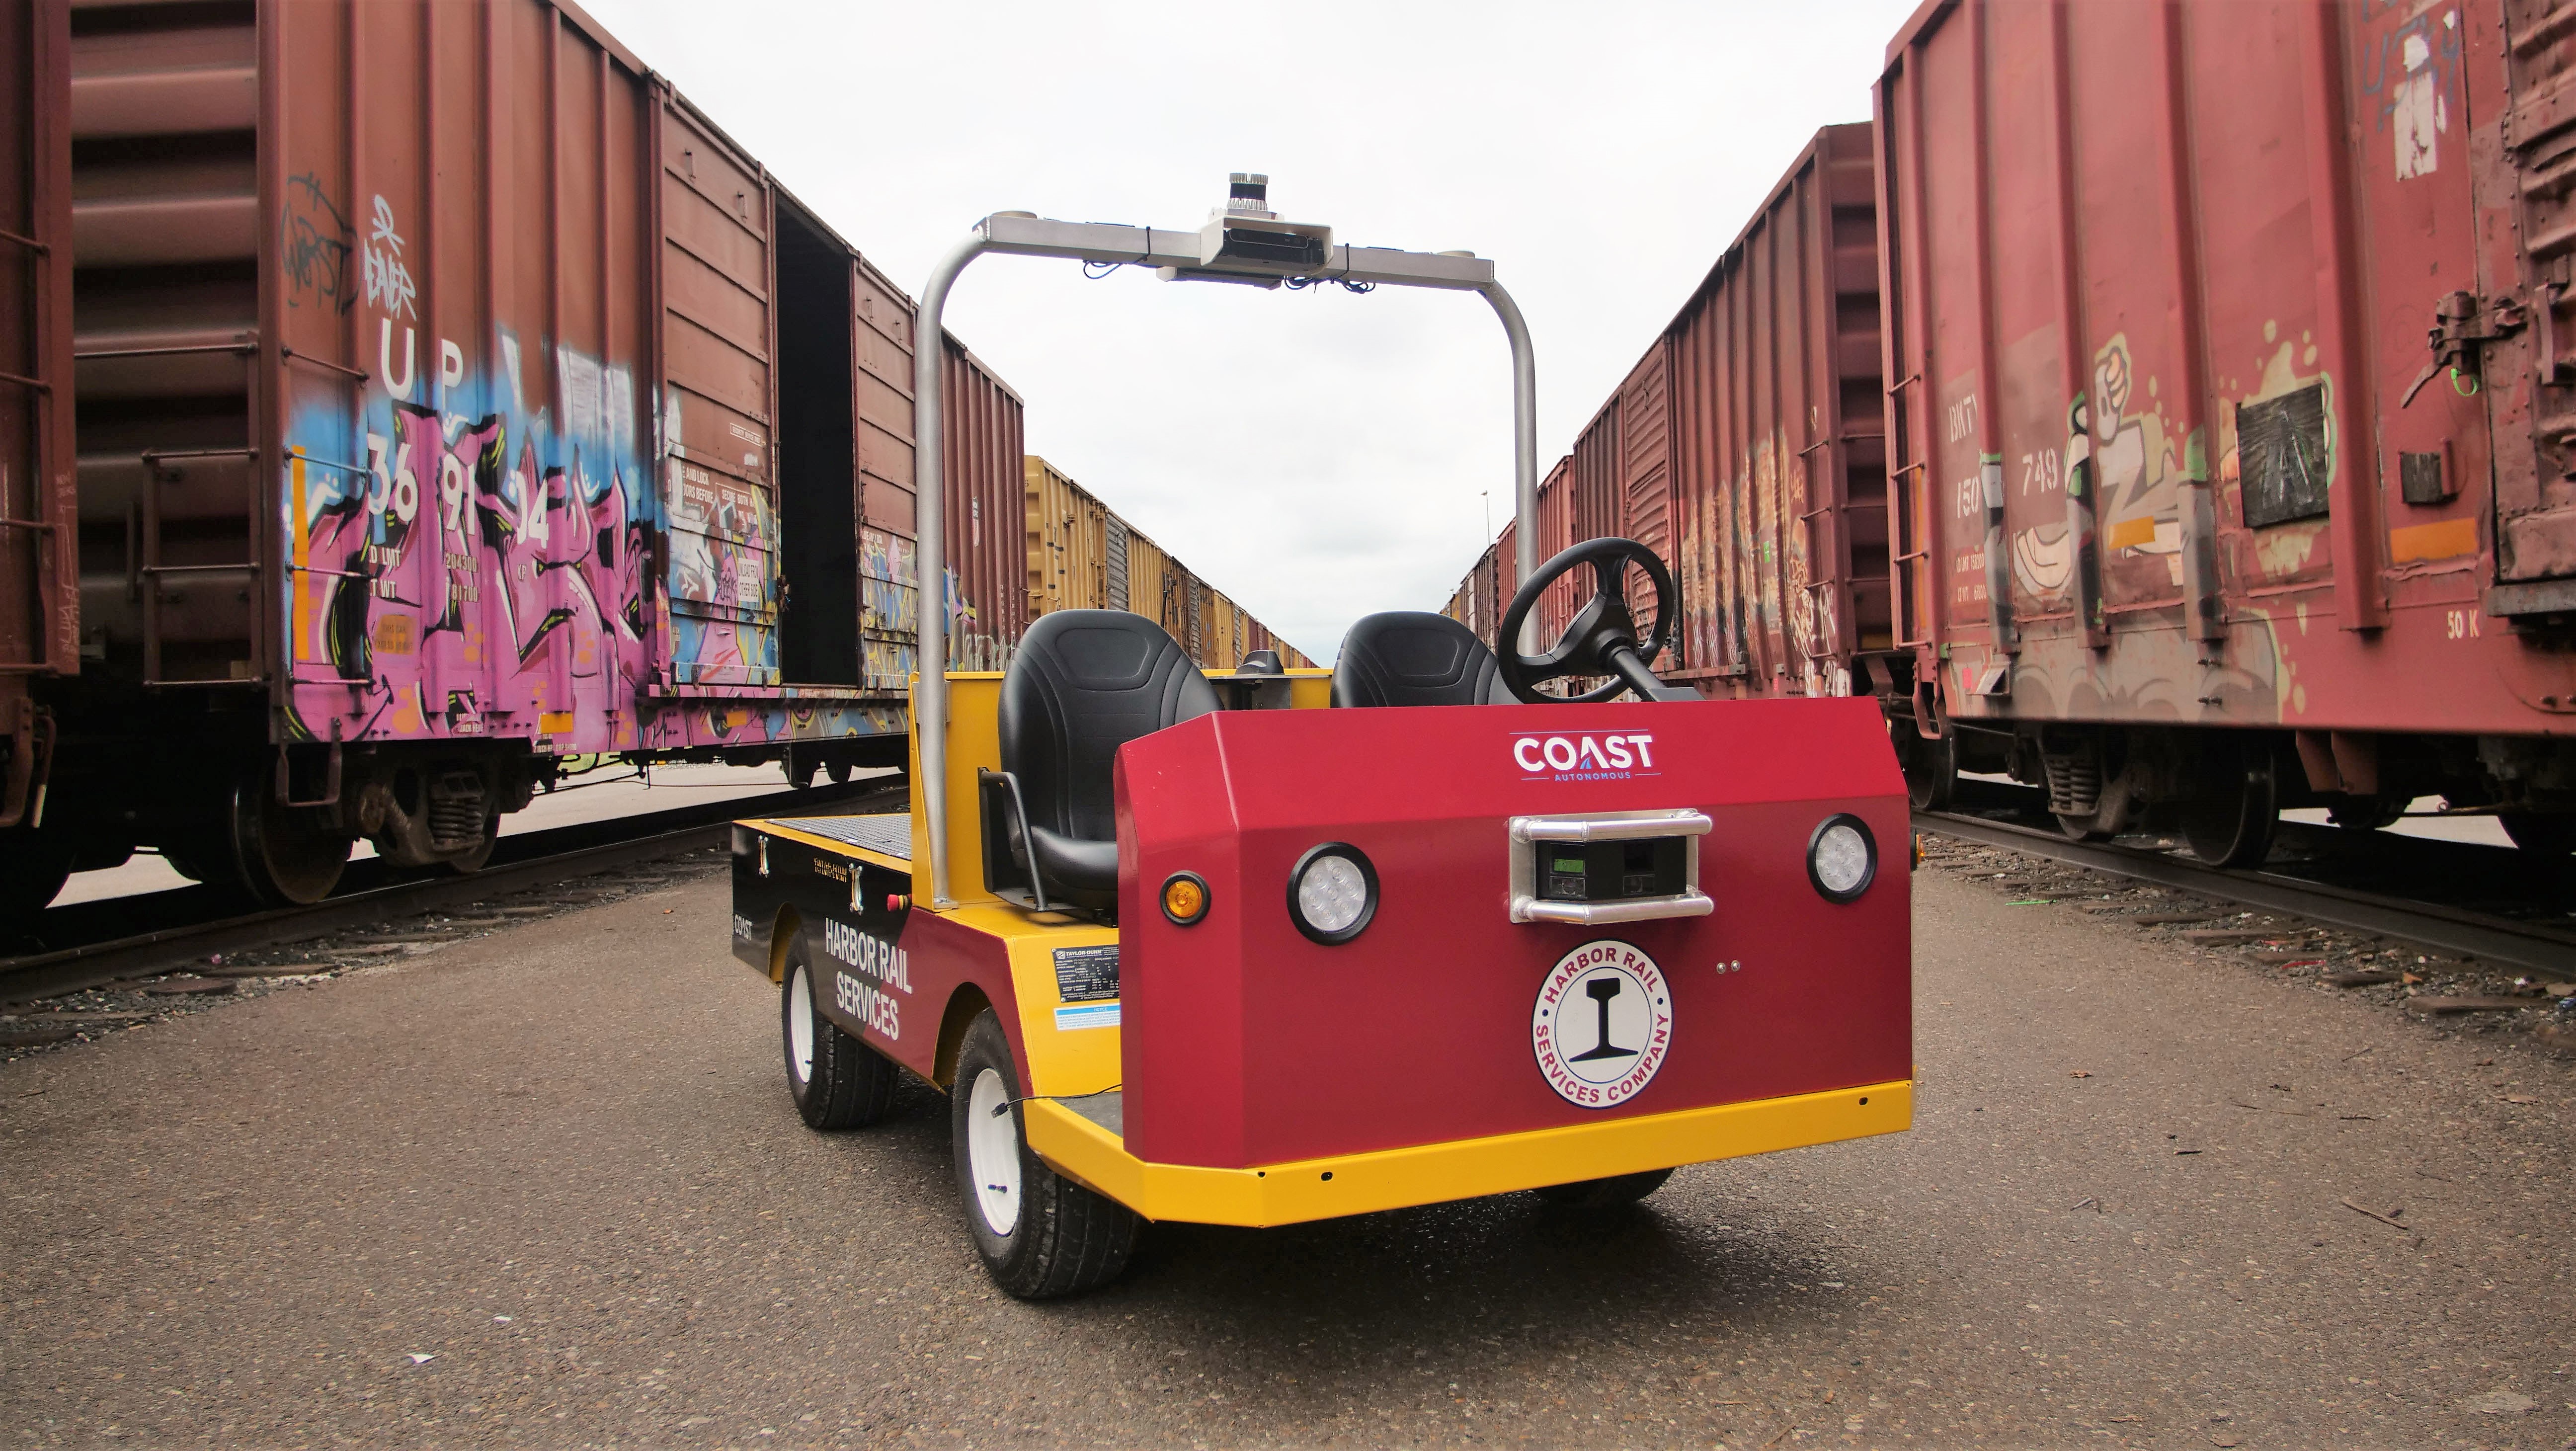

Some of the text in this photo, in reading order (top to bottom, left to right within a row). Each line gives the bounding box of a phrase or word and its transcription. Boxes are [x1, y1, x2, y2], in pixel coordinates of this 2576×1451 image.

[696, 469, 710, 485] LOCK
[1957, 448, 2058, 519] 150 749
[696, 487, 714, 503] BEFORE
[370, 545, 478, 572] D LMT 204300
[371, 578, 478, 602] T WT 81700
[739, 582, 750, 596] OTHER
[2447, 609, 2480, 640] 50 K
[1514, 735, 1653, 772] COAST
[1554, 772, 1631, 781] AUTONOMOUS
[734, 914, 752, 941] COAST
[825, 917, 912, 994] HARBOR RAIL
[1544, 947, 1658, 1005] HARBOR RAIL
[837, 971, 899, 1041] SERVICES
[1536, 1013, 1669, 1103] SERVICES COMPANY
